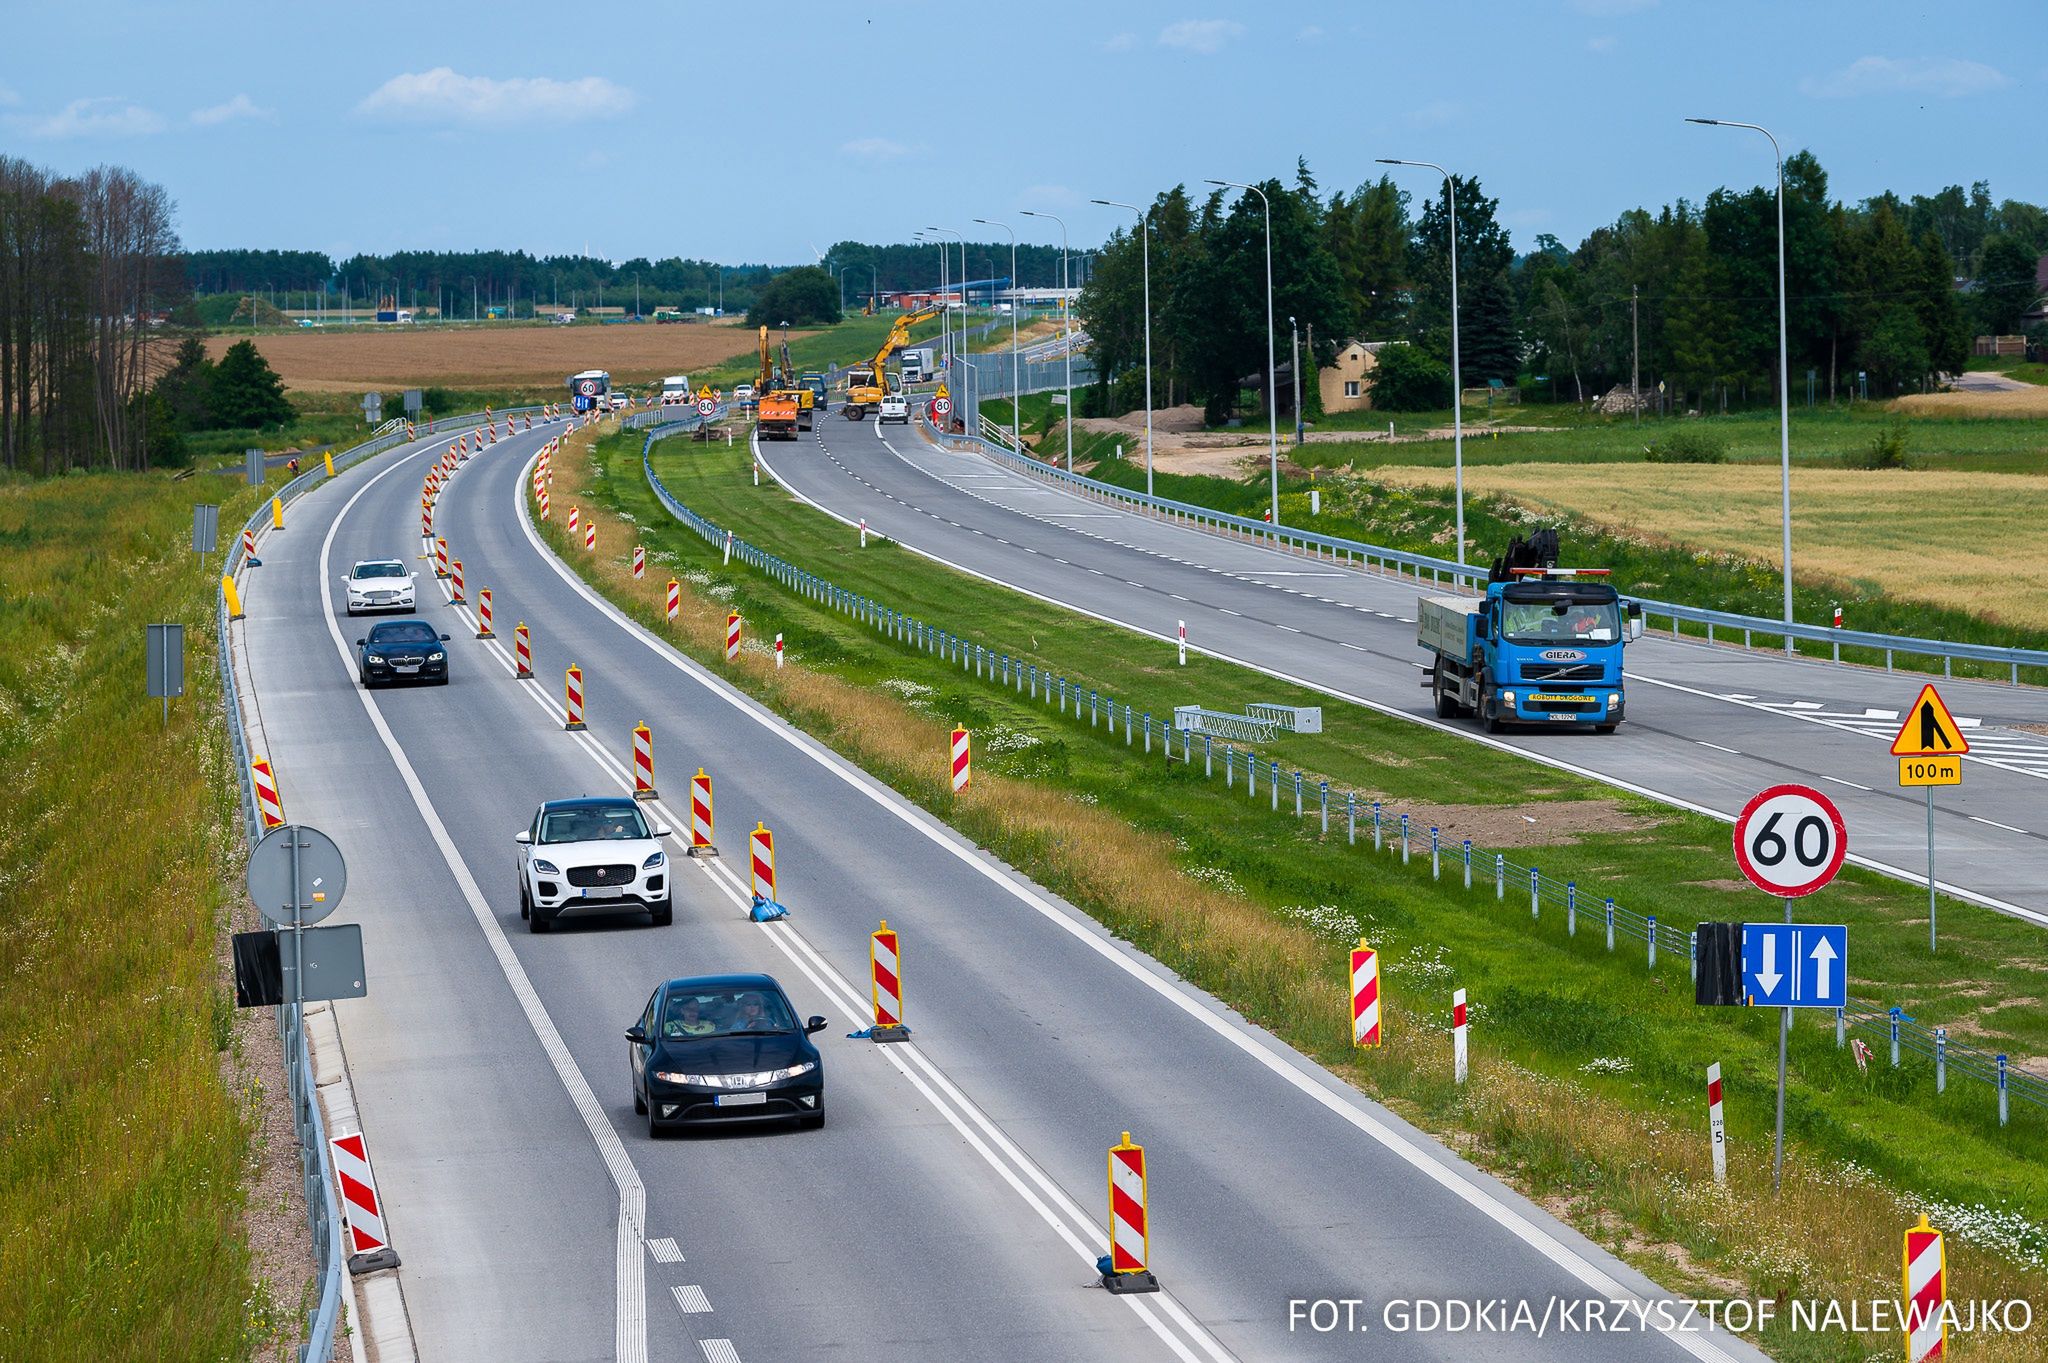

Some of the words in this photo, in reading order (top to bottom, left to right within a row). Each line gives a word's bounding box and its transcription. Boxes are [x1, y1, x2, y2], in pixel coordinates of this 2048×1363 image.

[582, 383, 594, 393] 60
[700, 402, 713, 412] 80
[936, 401, 950, 411] 80
[1545, 651, 1577, 659] GIERA
[1907, 763, 1937, 779] 100
[1940, 767, 1954, 778] m
[1752, 812, 1829, 867] 60
[1715, 1130, 1723, 1144] 5
